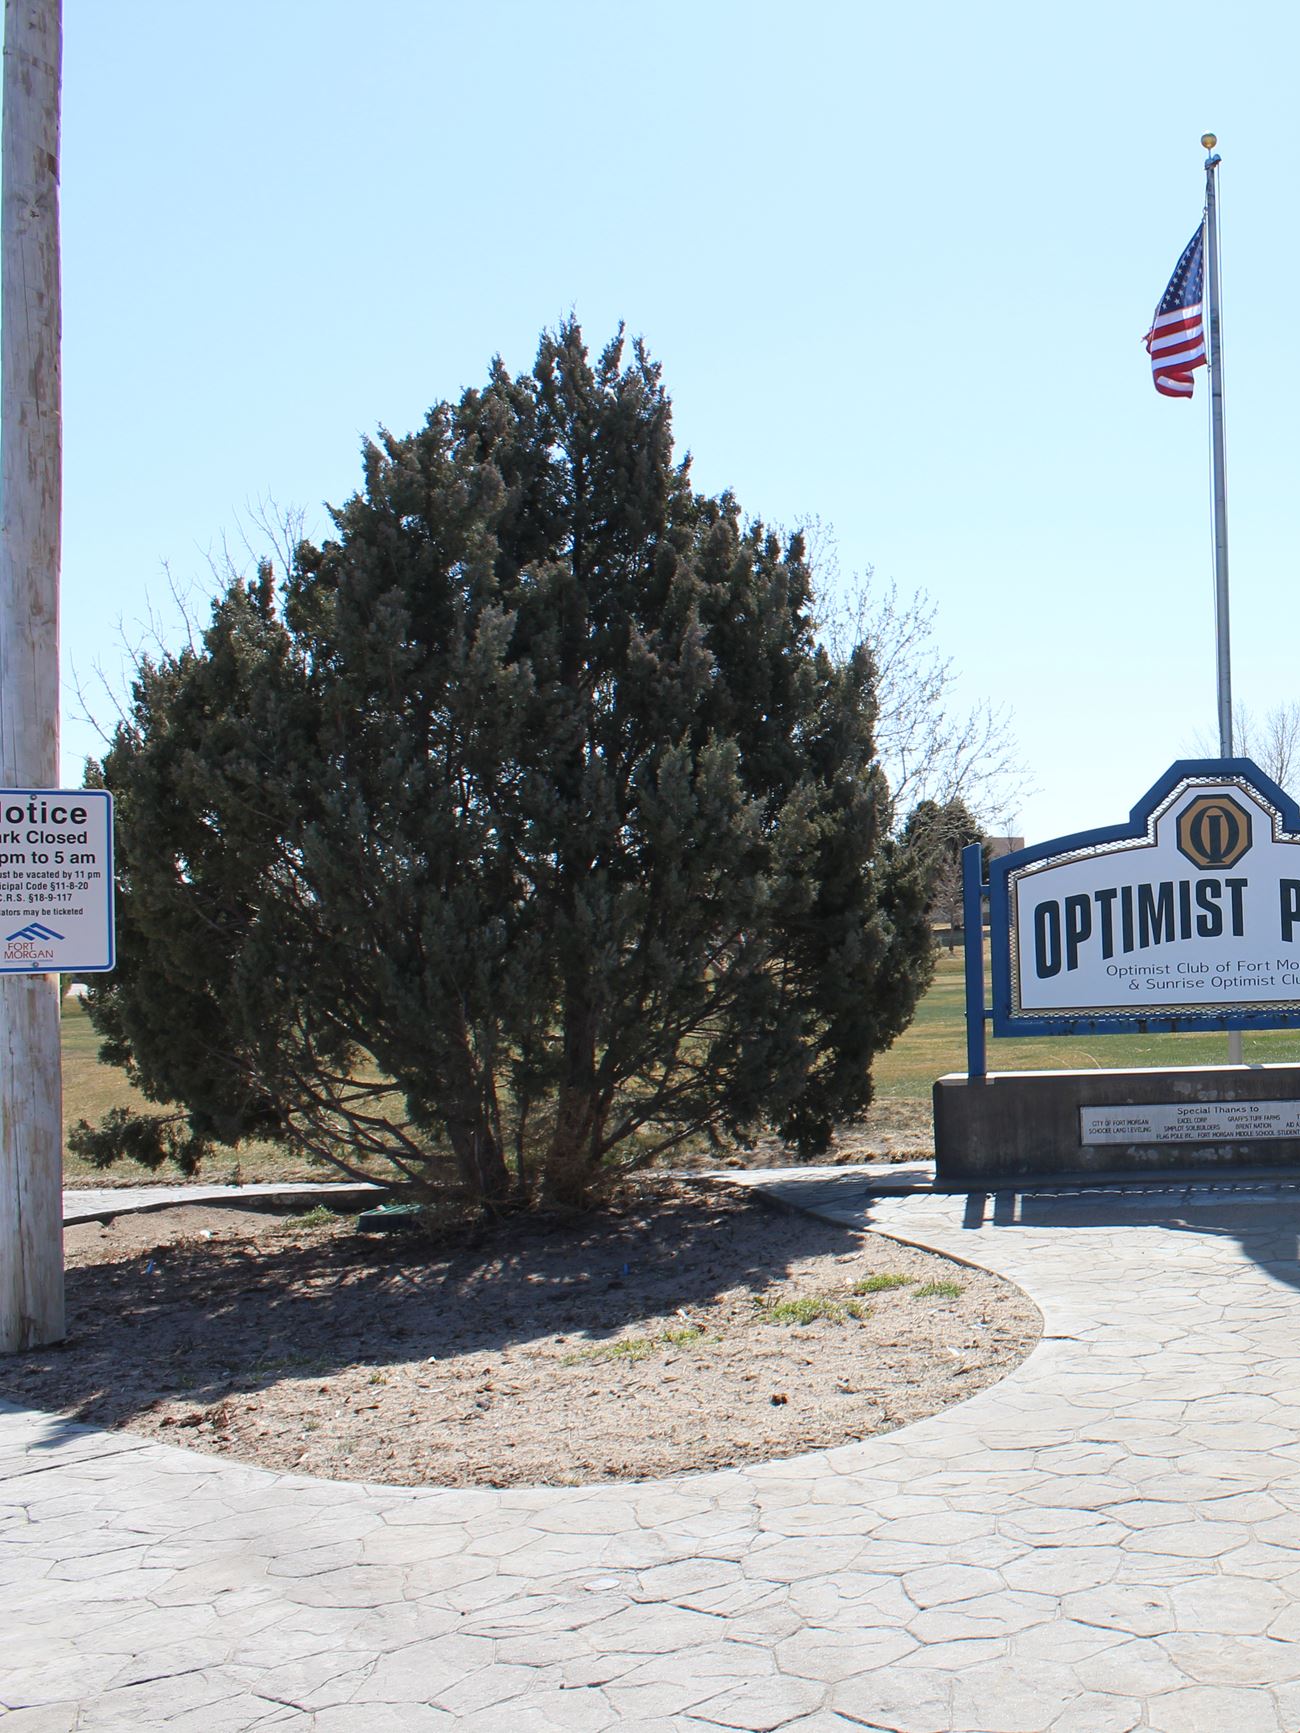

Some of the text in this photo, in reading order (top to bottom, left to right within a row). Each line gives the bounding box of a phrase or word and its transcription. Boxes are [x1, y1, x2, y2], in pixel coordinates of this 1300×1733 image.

[0, 801, 88, 825] otice
[0, 830, 88, 844] rk Closed
[0, 851, 96, 868] pm to 5 am
[13, 870, 24, 879] be
[26, 870, 60, 879] vacated
[62, 870, 73, 881] by
[75, 870, 85, 879] 11
[87, 871, 101, 880] pm
[26, 881, 48, 891] Code
[50, 881, 89, 892] §11-8-20
[28, 893, 73, 903] §18-9-117
[0, 907, 84, 917] ators may be ticketed
[1034, 878, 1248, 979] OPTIMIST
[7, 942, 35, 952] FORT
[4, 950, 54, 960] MORGAN
[1106, 963, 1171, 979] Optimist
[1176, 962, 1210, 974] Club
[1215, 960, 1231, 972] of
[1237, 960, 1271, 972] Fort
[1128, 978, 1140, 990] &
[1146, 977, 1205, 990] Sunrise
[1210, 974, 1276, 990] Optimist
[1177, 1105, 1260, 1116] Special Thanks to
